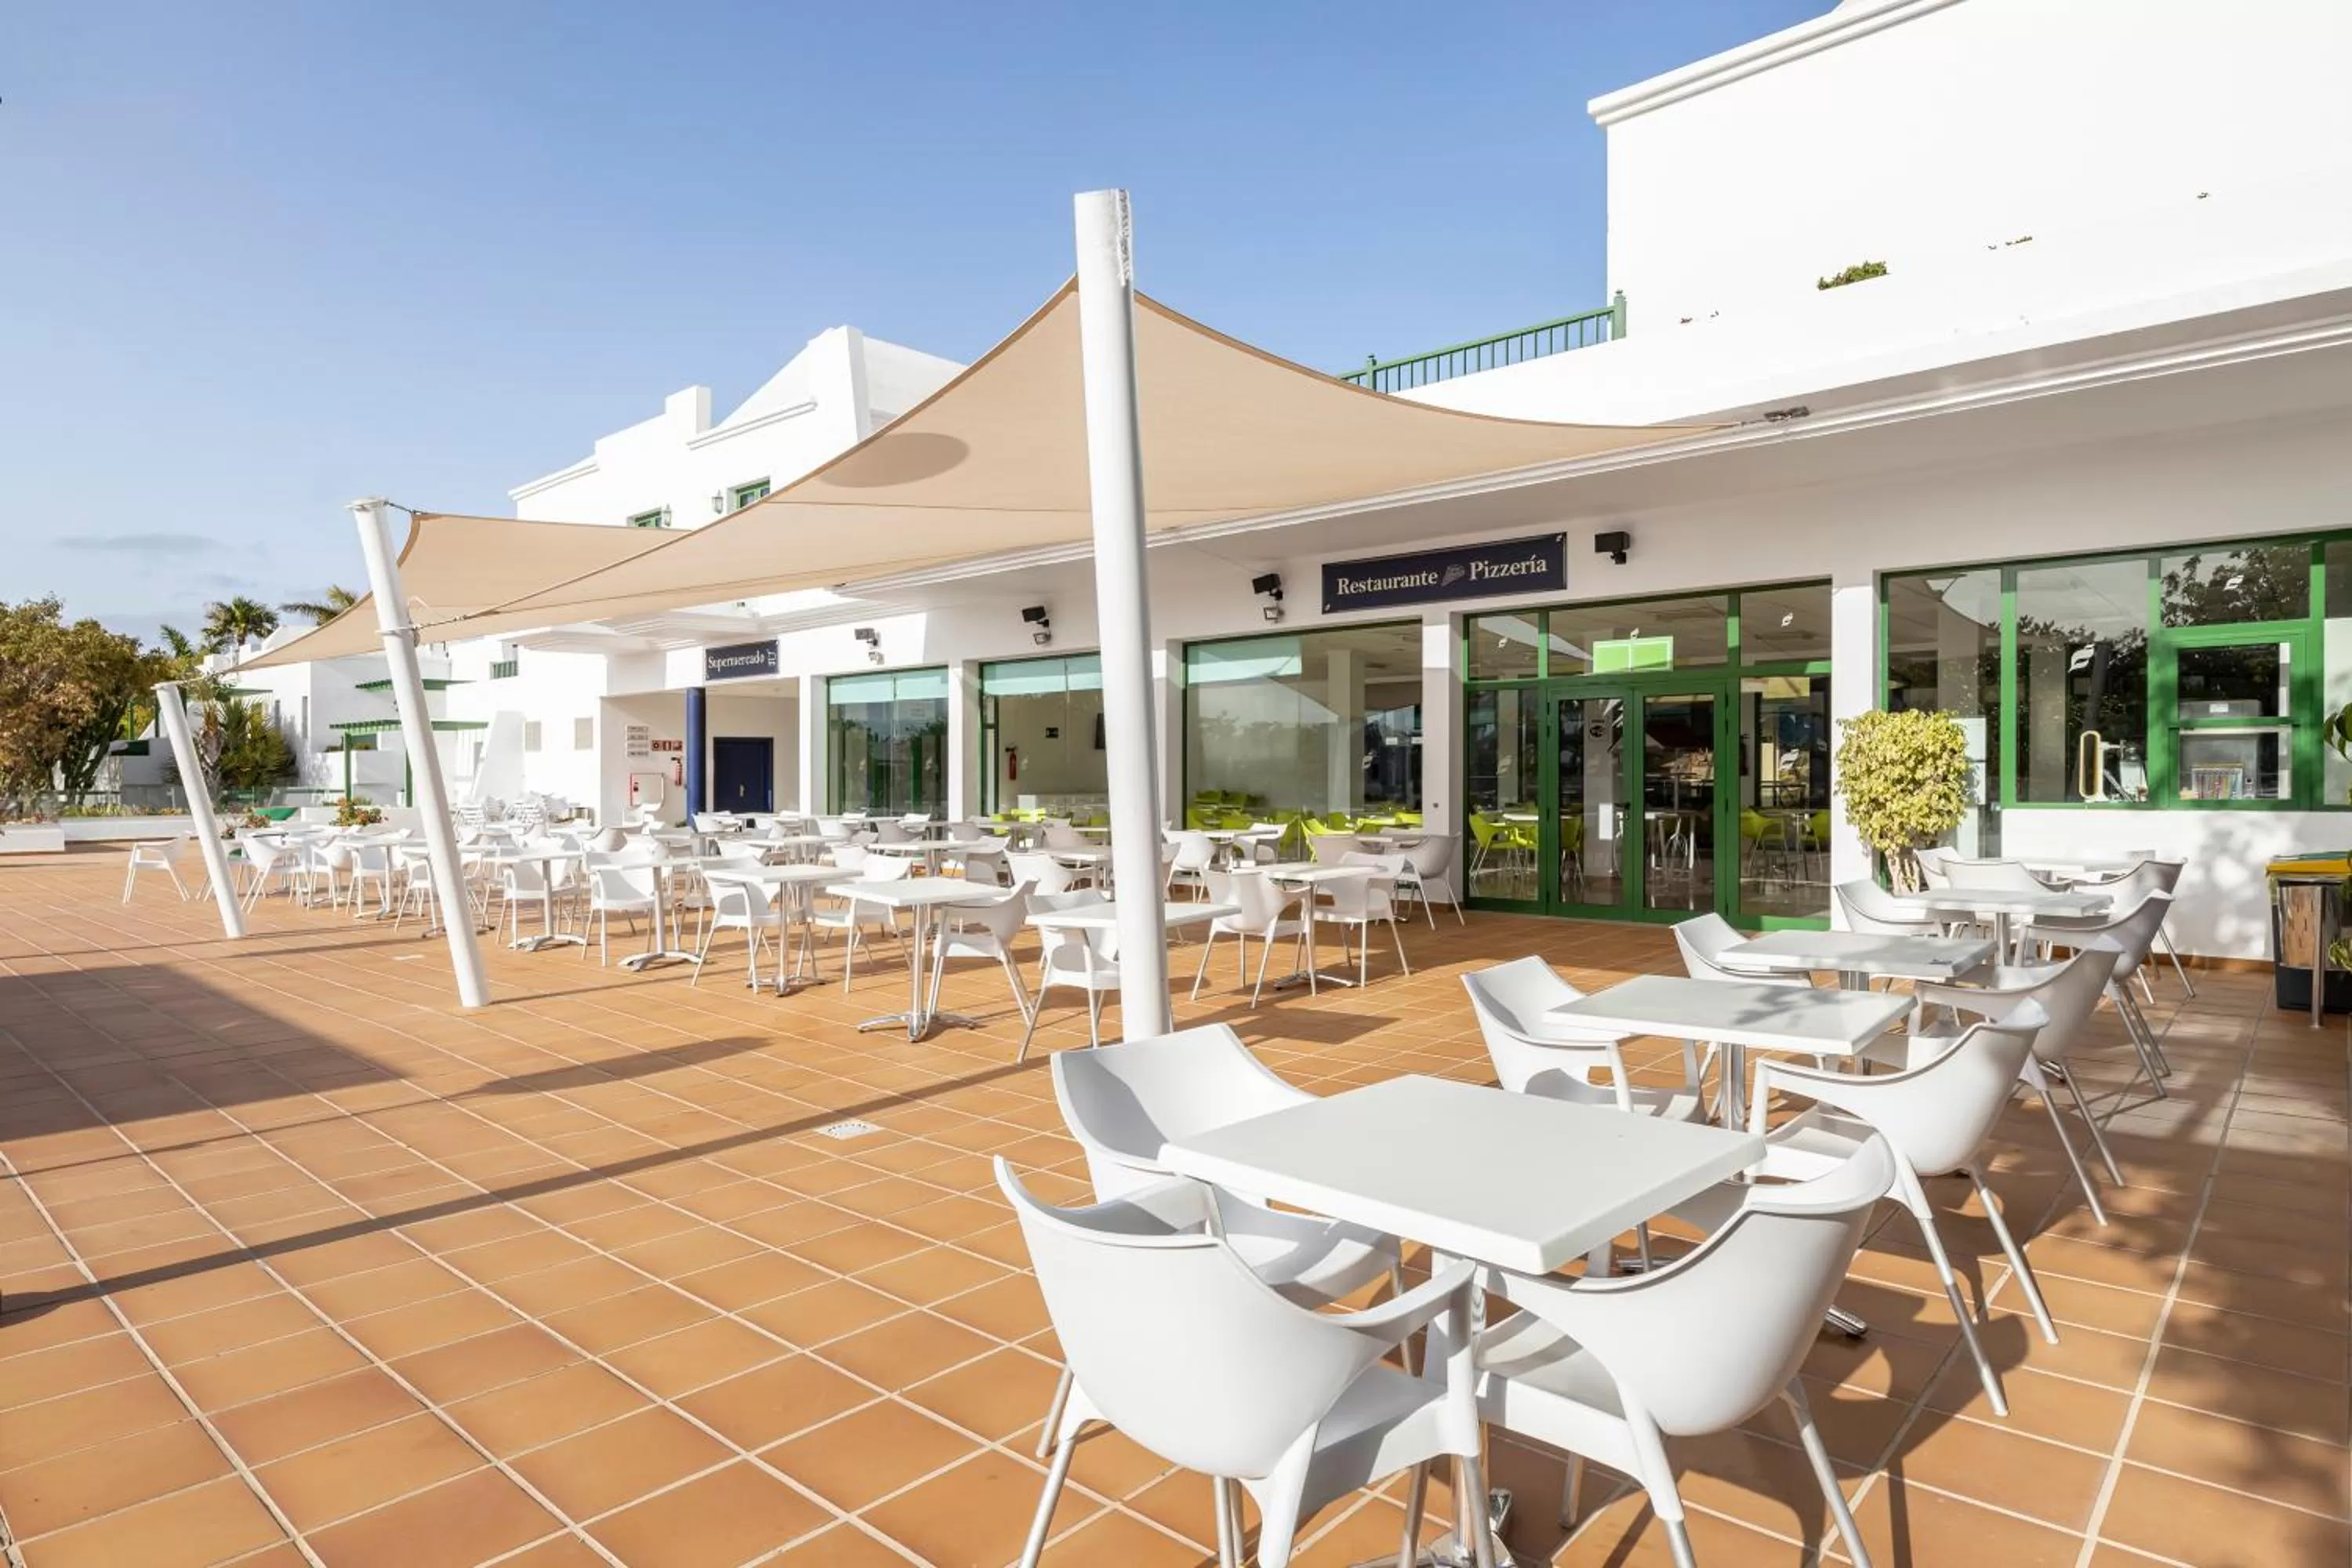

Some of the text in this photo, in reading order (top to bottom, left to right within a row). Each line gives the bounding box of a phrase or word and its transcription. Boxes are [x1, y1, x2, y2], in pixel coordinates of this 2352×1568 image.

[1336, 554, 1548, 595] Restaurante Pizzería
[708, 649, 765, 672] Supermercado
